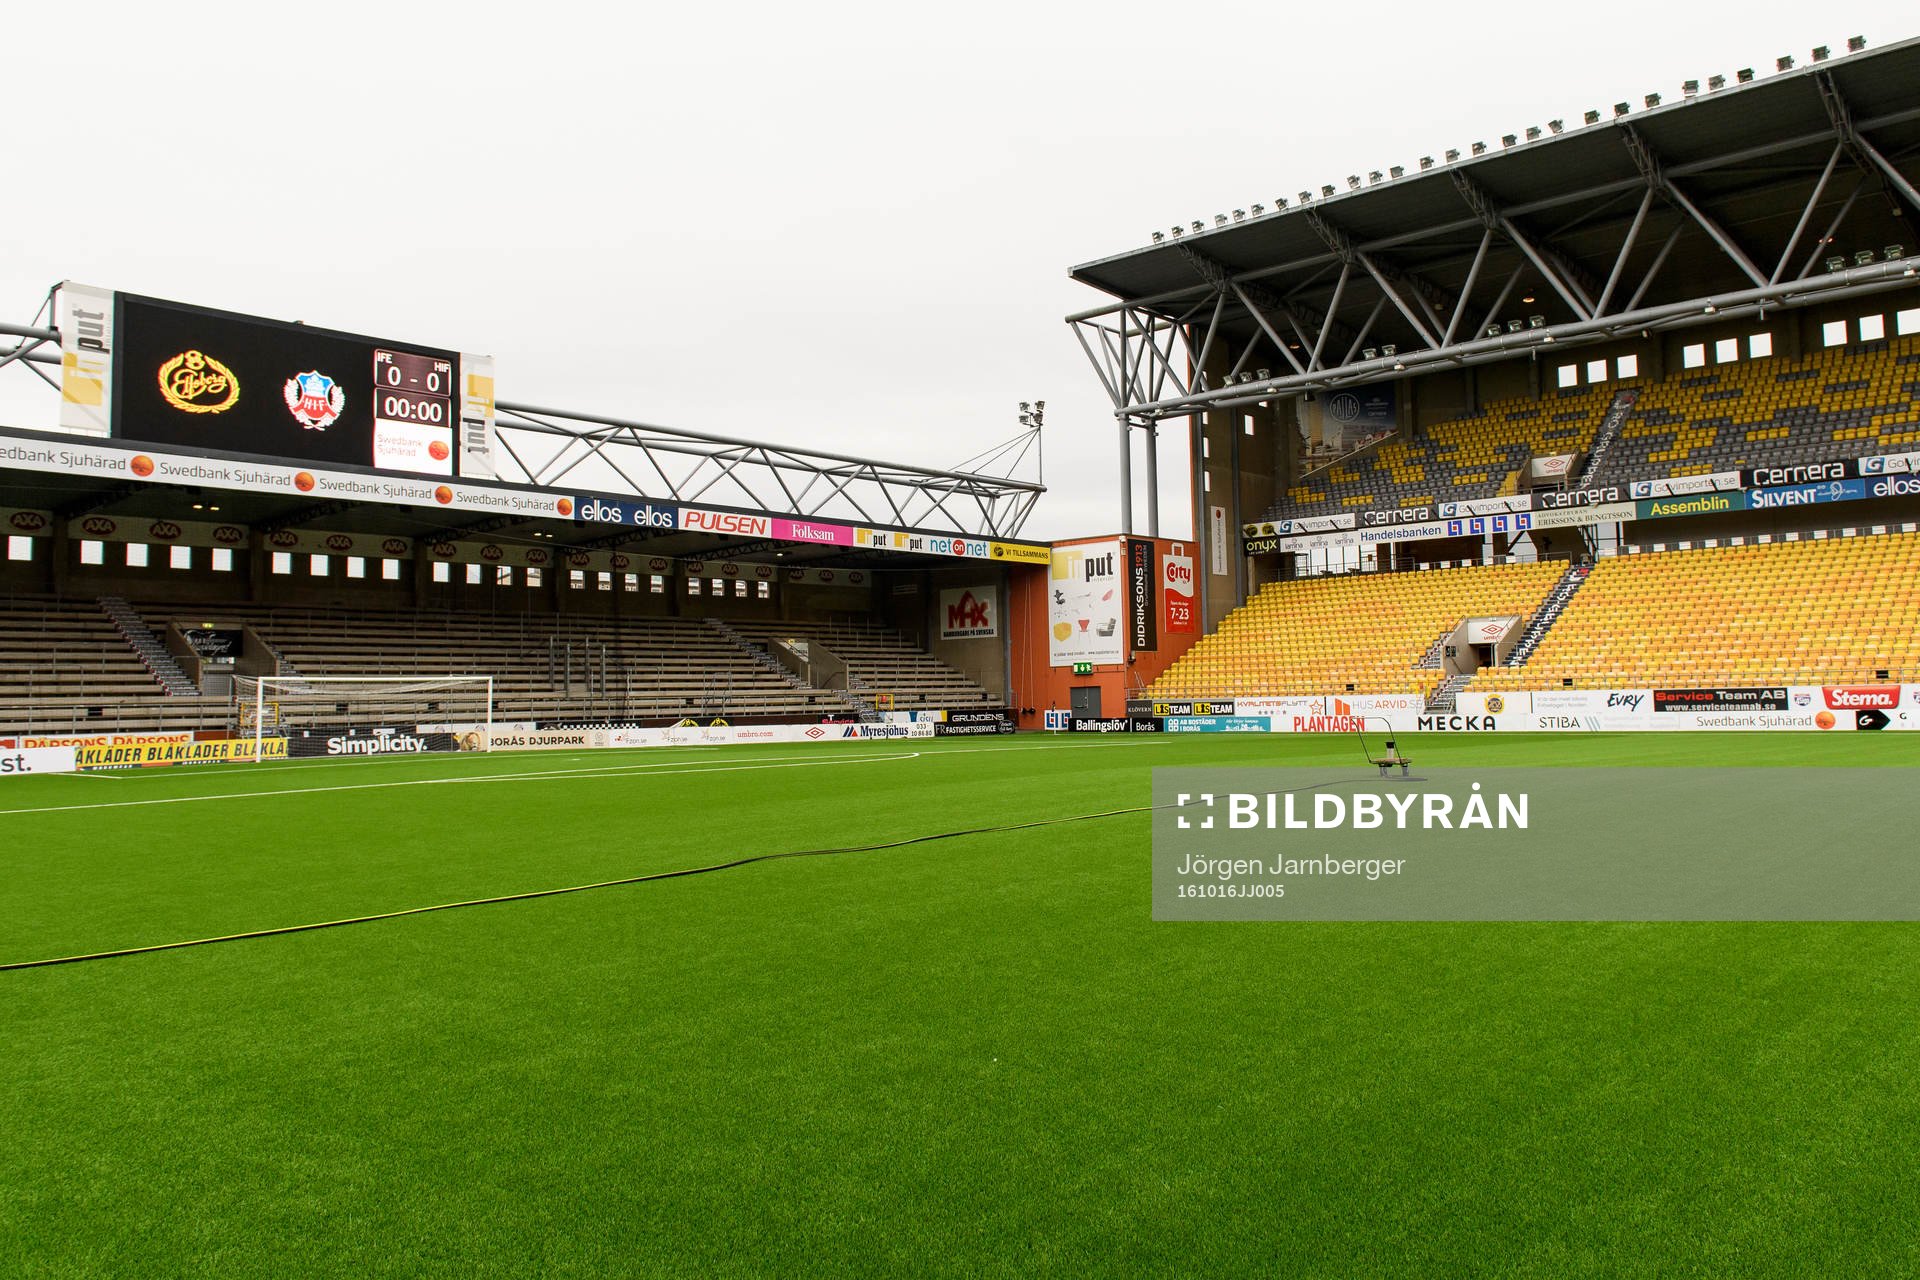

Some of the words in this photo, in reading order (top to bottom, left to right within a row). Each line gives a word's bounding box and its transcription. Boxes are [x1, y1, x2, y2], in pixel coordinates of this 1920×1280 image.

[377, 352, 393, 364] IFE
[434, 362, 450, 373] HIF
[387, 366, 401, 386] 0
[426, 373, 440, 392] 0
[384, 396, 442, 422] 00:00
[377, 434, 423, 447] Swedbank
[60, 452, 126, 470] Sjuhärad
[160, 462, 231, 480] Swedbank
[234, 470, 291, 486] Sjuhärad
[1753, 462, 1845, 485] Cernera
[319, 478, 380, 495] Swedbank
[383, 484, 432, 499] Sjuhärad
[1873, 476, 1920, 497] ellos
[456, 492, 509, 507] Swedbank
[512, 497, 554, 511] Sjuhärad
[1542, 487, 1619, 508] Cernera
[581, 500, 622, 523] ellos
[1650, 496, 1729, 516] Assemblin
[13, 513, 42, 526] AXA
[634, 505, 672, 528] ellos
[684, 511, 766, 535] PULSEN
[1364, 507, 1429, 525] Cernera
[1585, 511, 1633, 521] BENGTSSON
[86, 520, 113, 532] AXA
[152, 524, 180, 537] AXA
[792, 524, 834, 541] Folksam
[215, 528, 241, 541] AXA
[272, 532, 297, 545] AXA
[1361, 526, 1441, 541] Handelsbanken
[327, 536, 351, 548] AXA
[384, 541, 406, 552] AXA
[1246, 539, 1277, 552] onyx
[1335, 537, 1354, 545] lamina
[528, 551, 546, 562] AXA
[651, 560, 667, 570] AXA
[1167, 562, 1191, 583] City
[948, 590, 989, 629] MAX
[1171, 608, 1189, 620] 7-23
[1607, 693, 1645, 712] EVRY
[1656, 692, 1714, 701] Service
[1716, 691, 1757, 700] Team
[1760, 690, 1786, 699] AB
[1832, 689, 1893, 706] Stema.
[1665, 703, 1776, 712] www.serviceteamab.se
[1076, 718, 1126, 733] Ballingslöv
[1136, 721, 1156, 731] Borås
[1294, 716, 1365, 732] PLANTAGEN
[1418, 716, 1496, 730] MECKA
[1539, 716, 1581, 728] STIBA
[1697, 716, 1755, 727] Swedbank
[1759, 715, 1812, 729] Sjuhärad
[737, 730, 773, 738] umbro.com
[861, 725, 908, 738] Myresjöhus
[327, 734, 428, 755] Simplicity.
[529, 736, 584, 745] DJURPARK
[1, 754, 31, 772] st.
